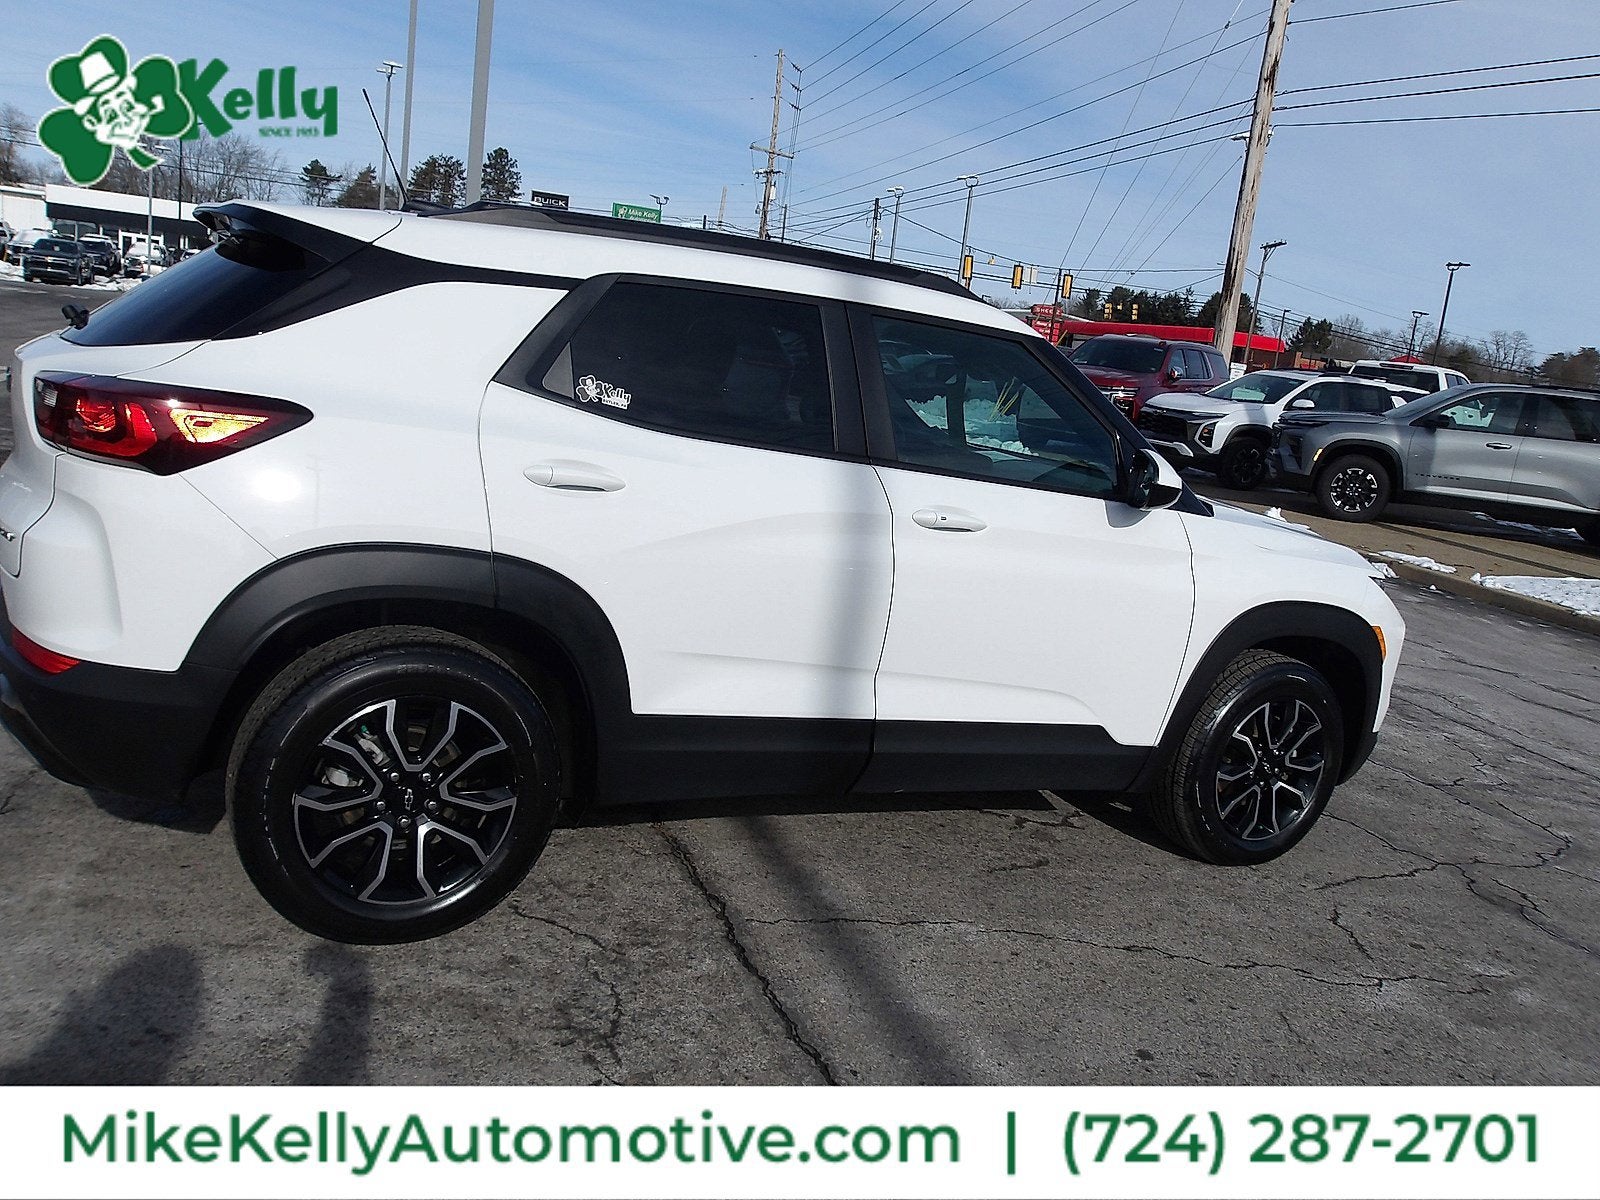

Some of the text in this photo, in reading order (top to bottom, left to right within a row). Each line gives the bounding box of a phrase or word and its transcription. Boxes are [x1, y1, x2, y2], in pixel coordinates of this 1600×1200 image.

[534, 196, 566, 207] BUICK
[628, 208, 642, 217] Mike
[643, 210, 658, 220] Kelly
[603, 384, 630, 403] Kelly
